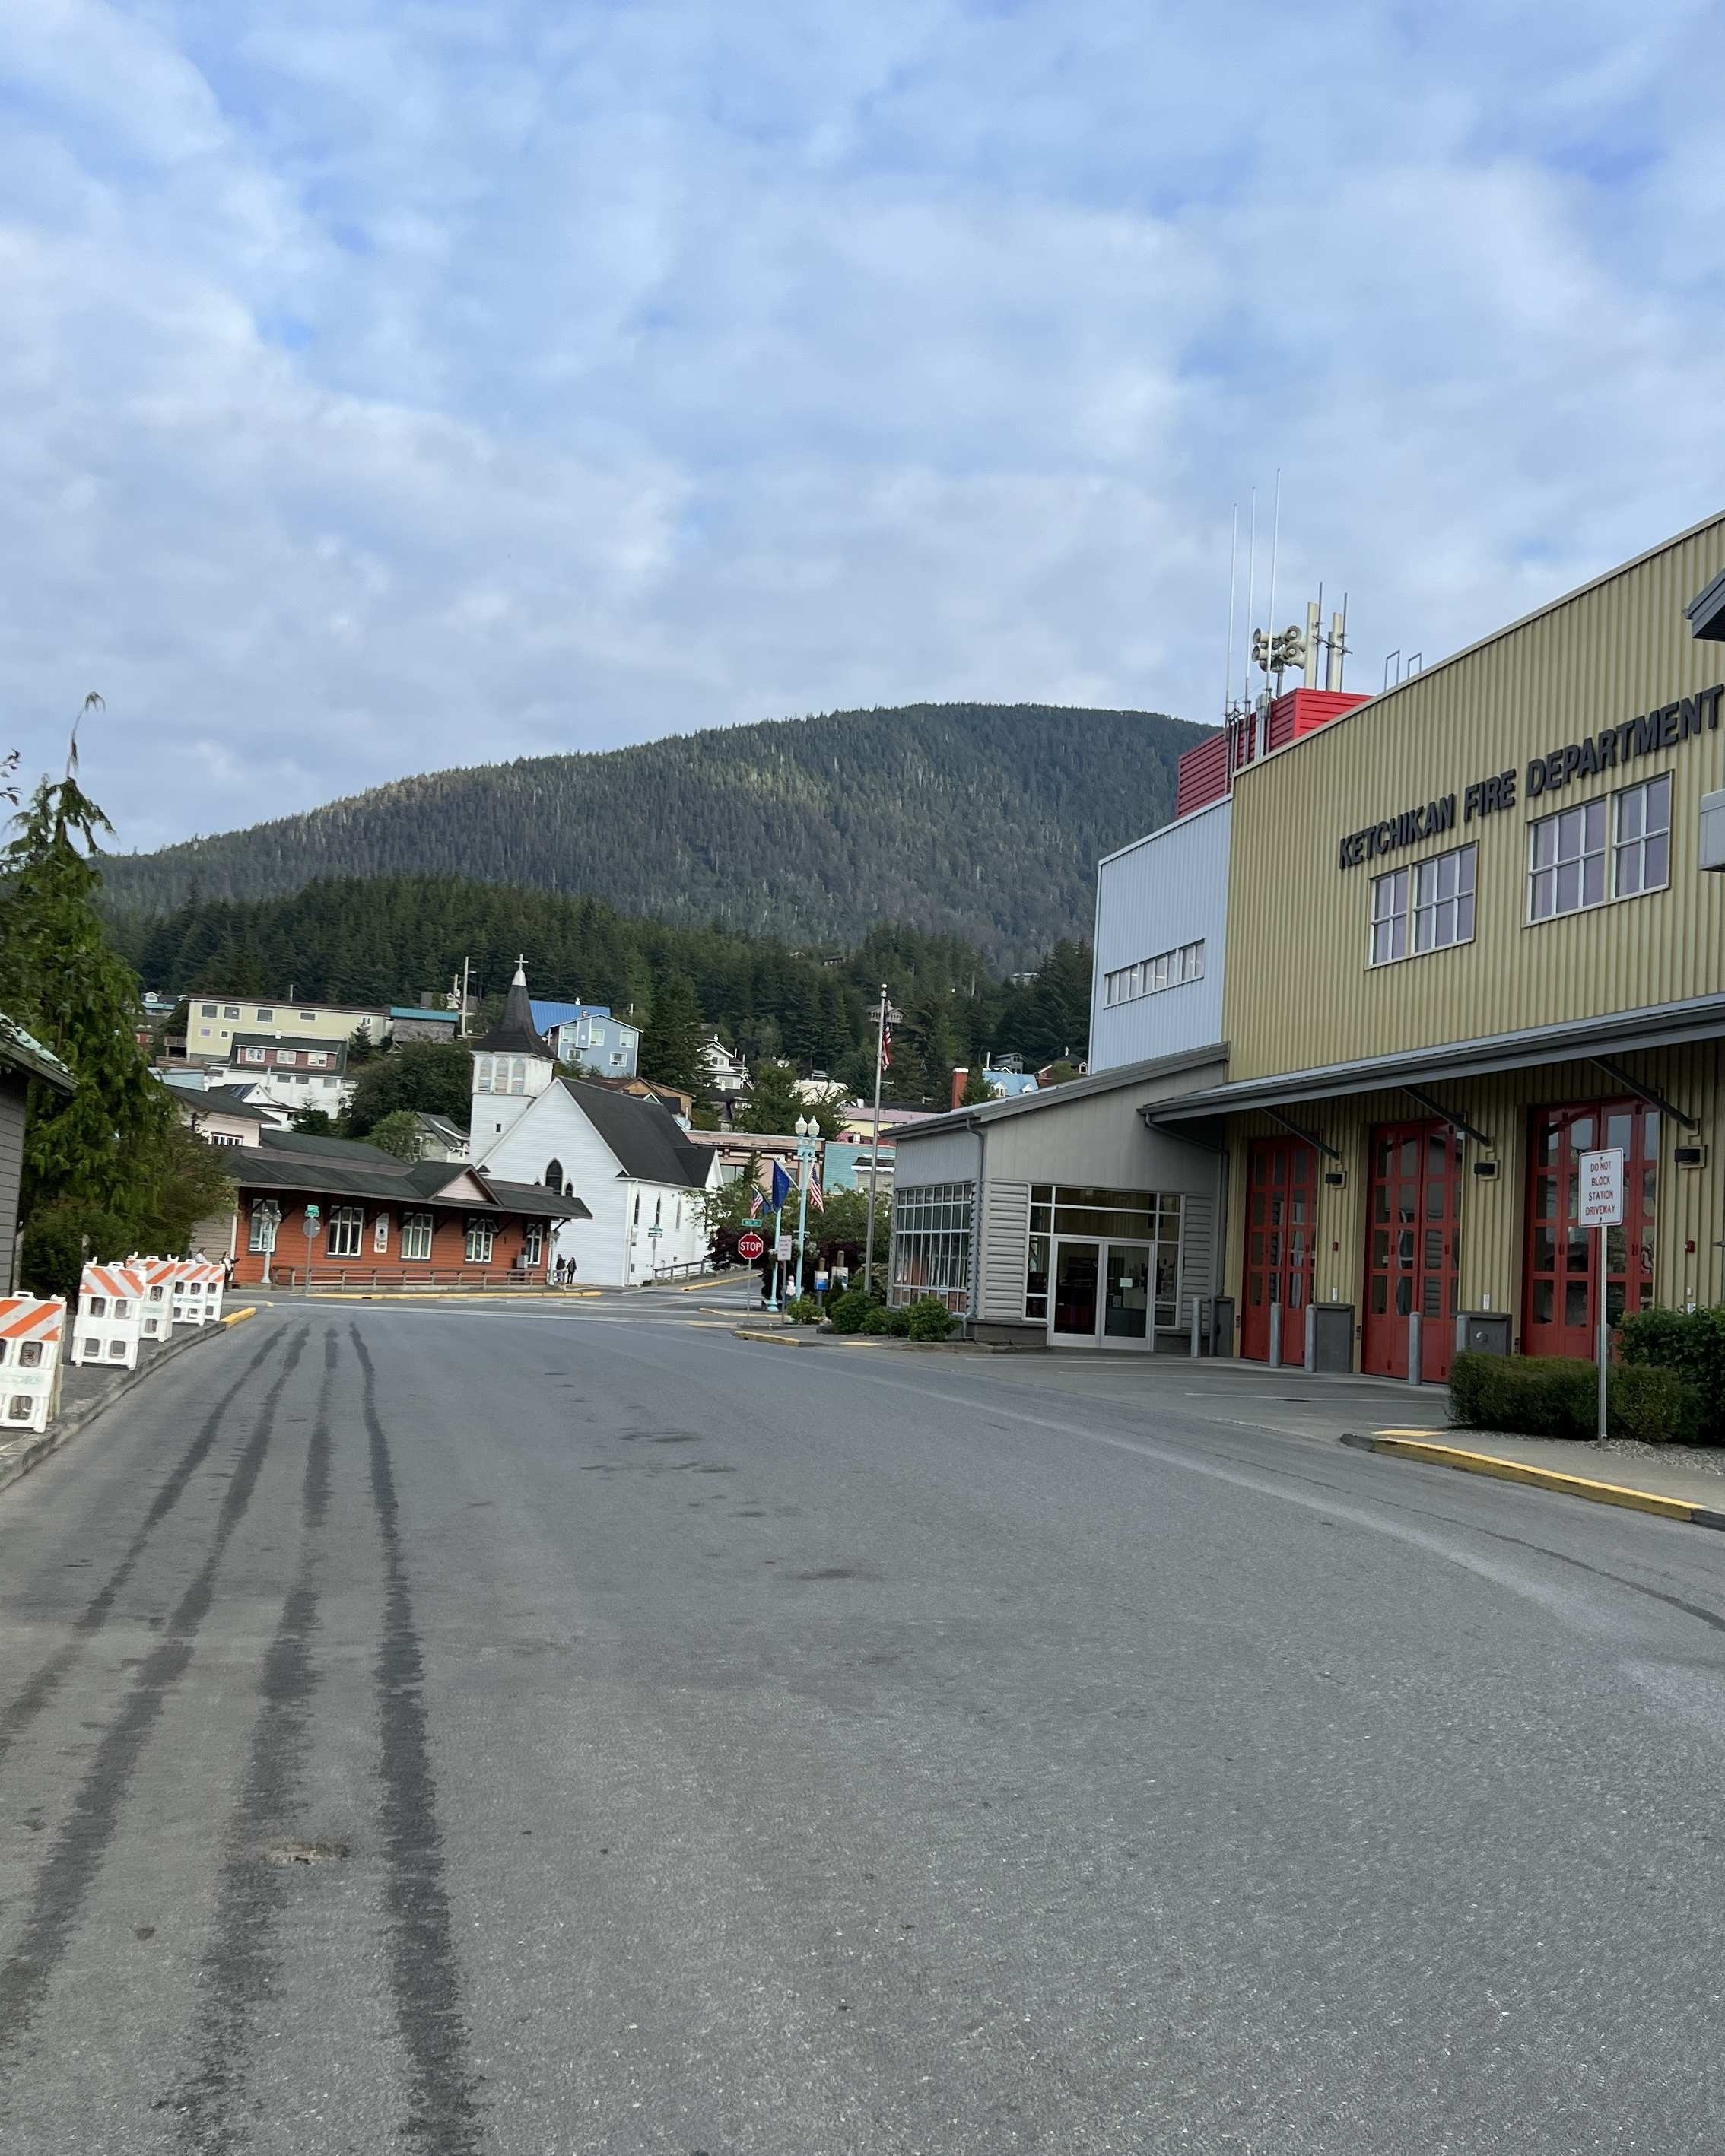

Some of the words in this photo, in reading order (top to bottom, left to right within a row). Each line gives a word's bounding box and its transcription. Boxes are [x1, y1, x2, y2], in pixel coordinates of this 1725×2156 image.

[1339, 792, 1456, 869] KETCHIKAN
[1463, 768, 1516, 822] FIRE
[1526, 684, 1724, 797] DEPARTMENT
[1590, 1163, 1600, 1173] DO
[1600, 1161, 1612, 1170] NOT
[1591, 1176, 1611, 1186] BLOCK
[1588, 1190, 1613, 1202] STATION
[1585, 1204, 1615, 1216] DRIVEWAY
[740, 1241, 761, 1252] STOP
